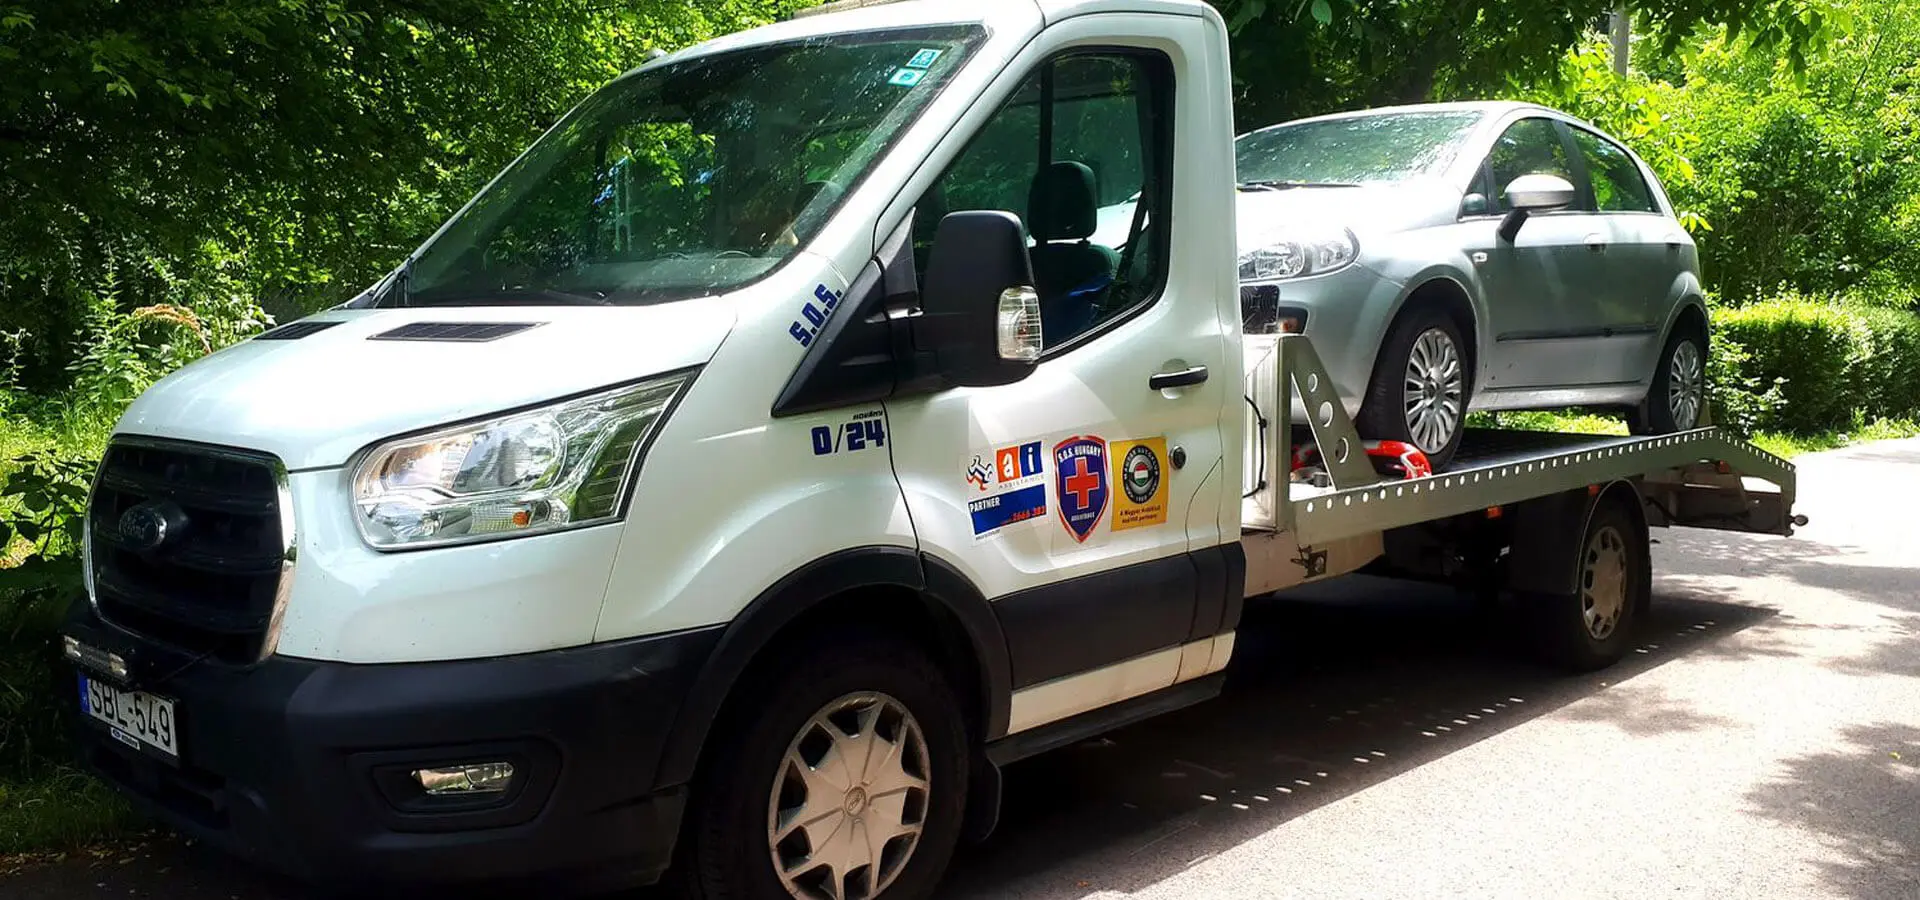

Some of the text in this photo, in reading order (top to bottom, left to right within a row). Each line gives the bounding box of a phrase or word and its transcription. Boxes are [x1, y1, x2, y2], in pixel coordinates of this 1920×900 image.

[789, 283, 842, 348] S.O.S.
[811, 419, 885, 456] 0/24
[1074, 445, 1102, 457] HUNGARY
[969, 497, 1000, 513] PARTNER
[90, 679, 171, 748] SBL-549
